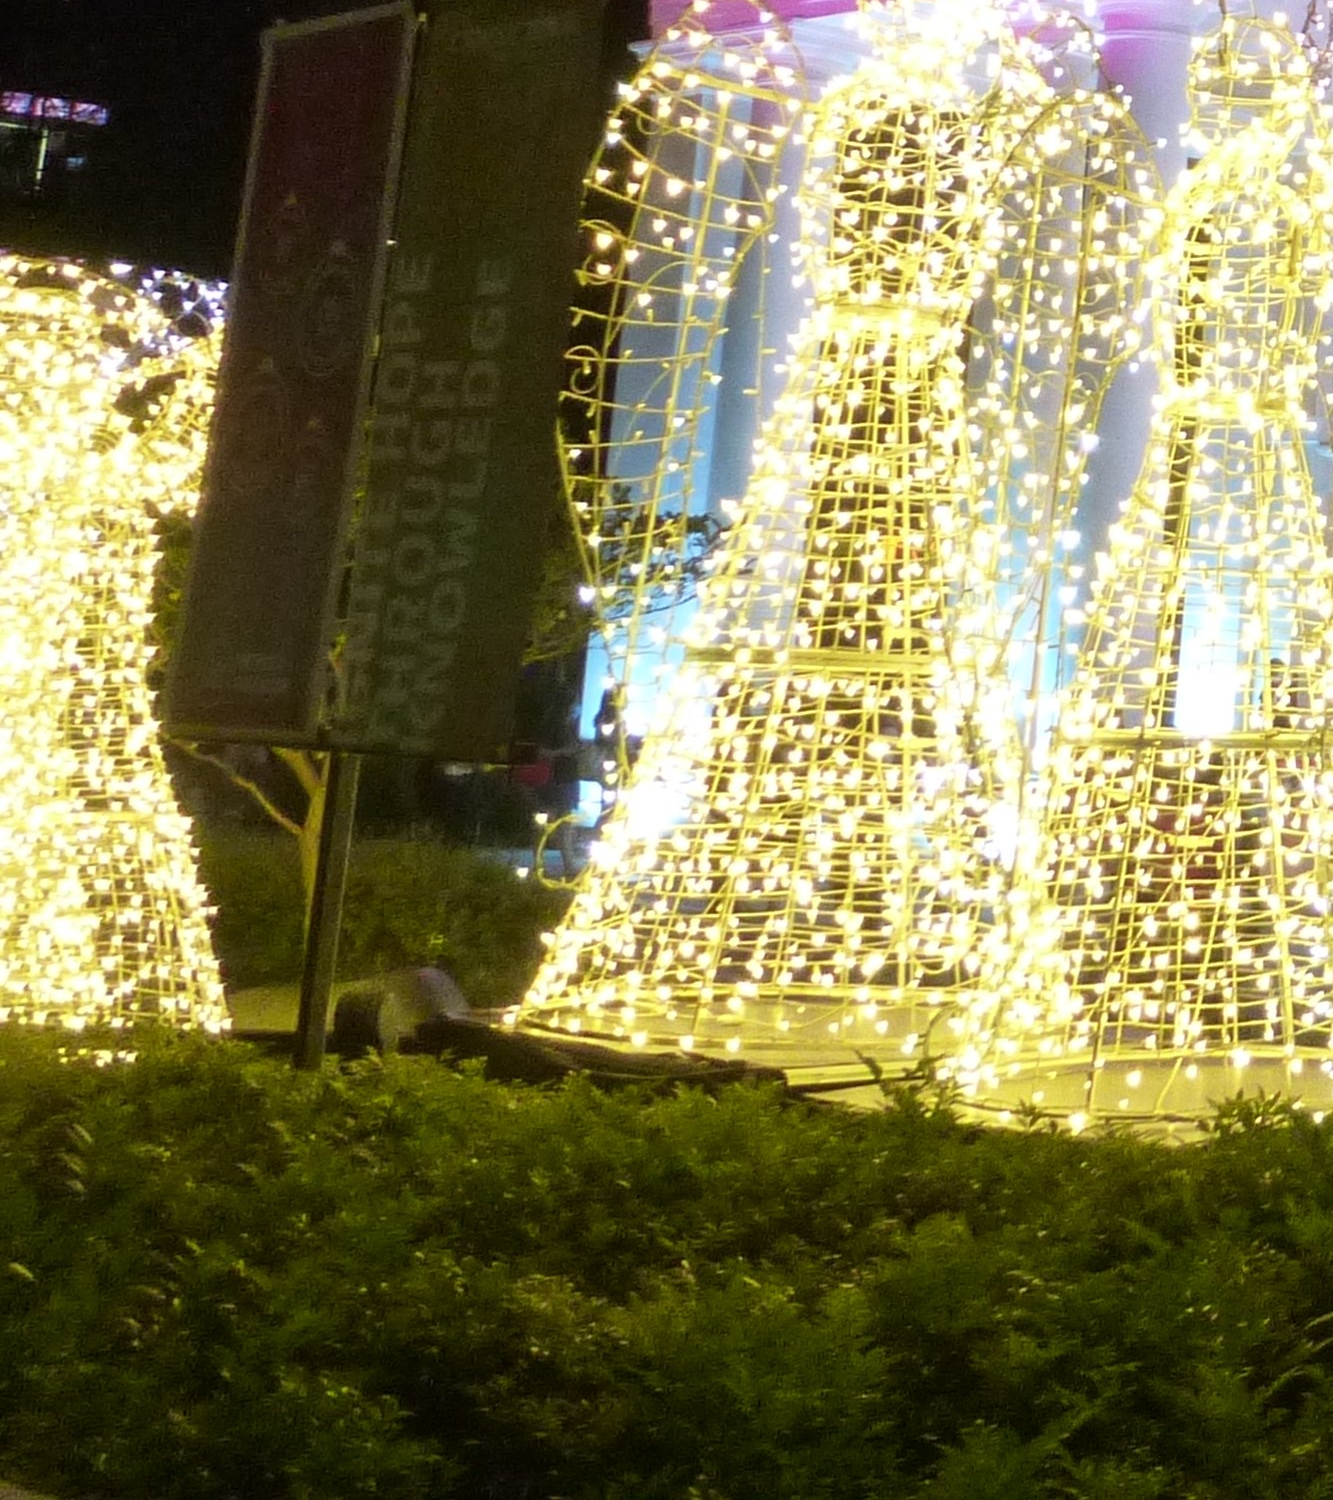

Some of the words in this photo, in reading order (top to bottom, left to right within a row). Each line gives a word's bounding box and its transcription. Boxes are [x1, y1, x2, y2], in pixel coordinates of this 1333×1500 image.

[362, 254, 433, 460] HOPE
[401, 256, 514, 752] KNOWLEDGE
[364, 361, 459, 743] THROUGH
